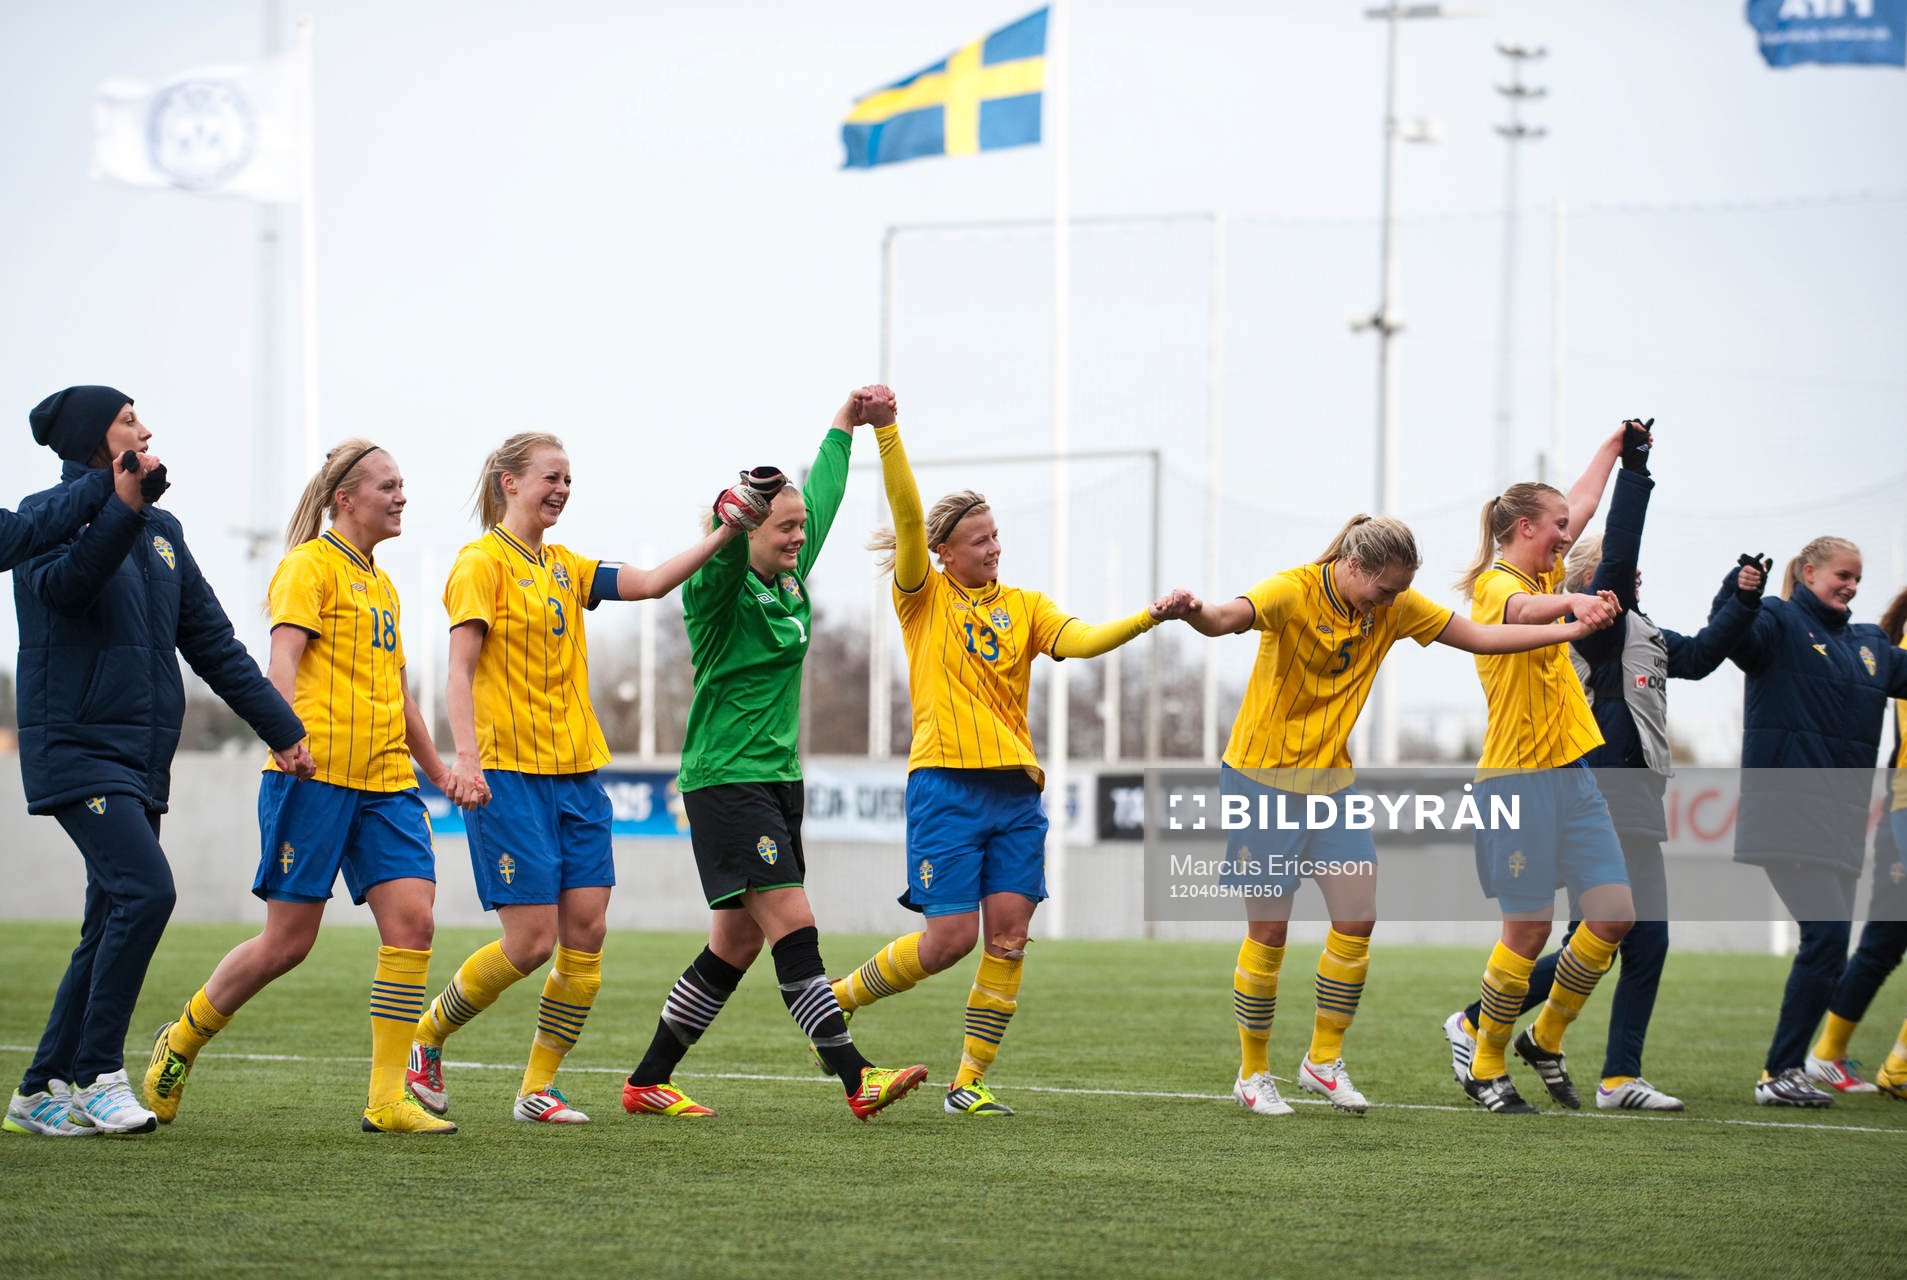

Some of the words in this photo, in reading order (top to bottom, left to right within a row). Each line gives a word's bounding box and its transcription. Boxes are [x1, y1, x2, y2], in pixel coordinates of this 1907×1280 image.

[369, 606, 397, 653] 18
[547, 596, 566, 636] 3
[963, 621, 1000, 662] 13
[1331, 640, 1354, 675] 5
